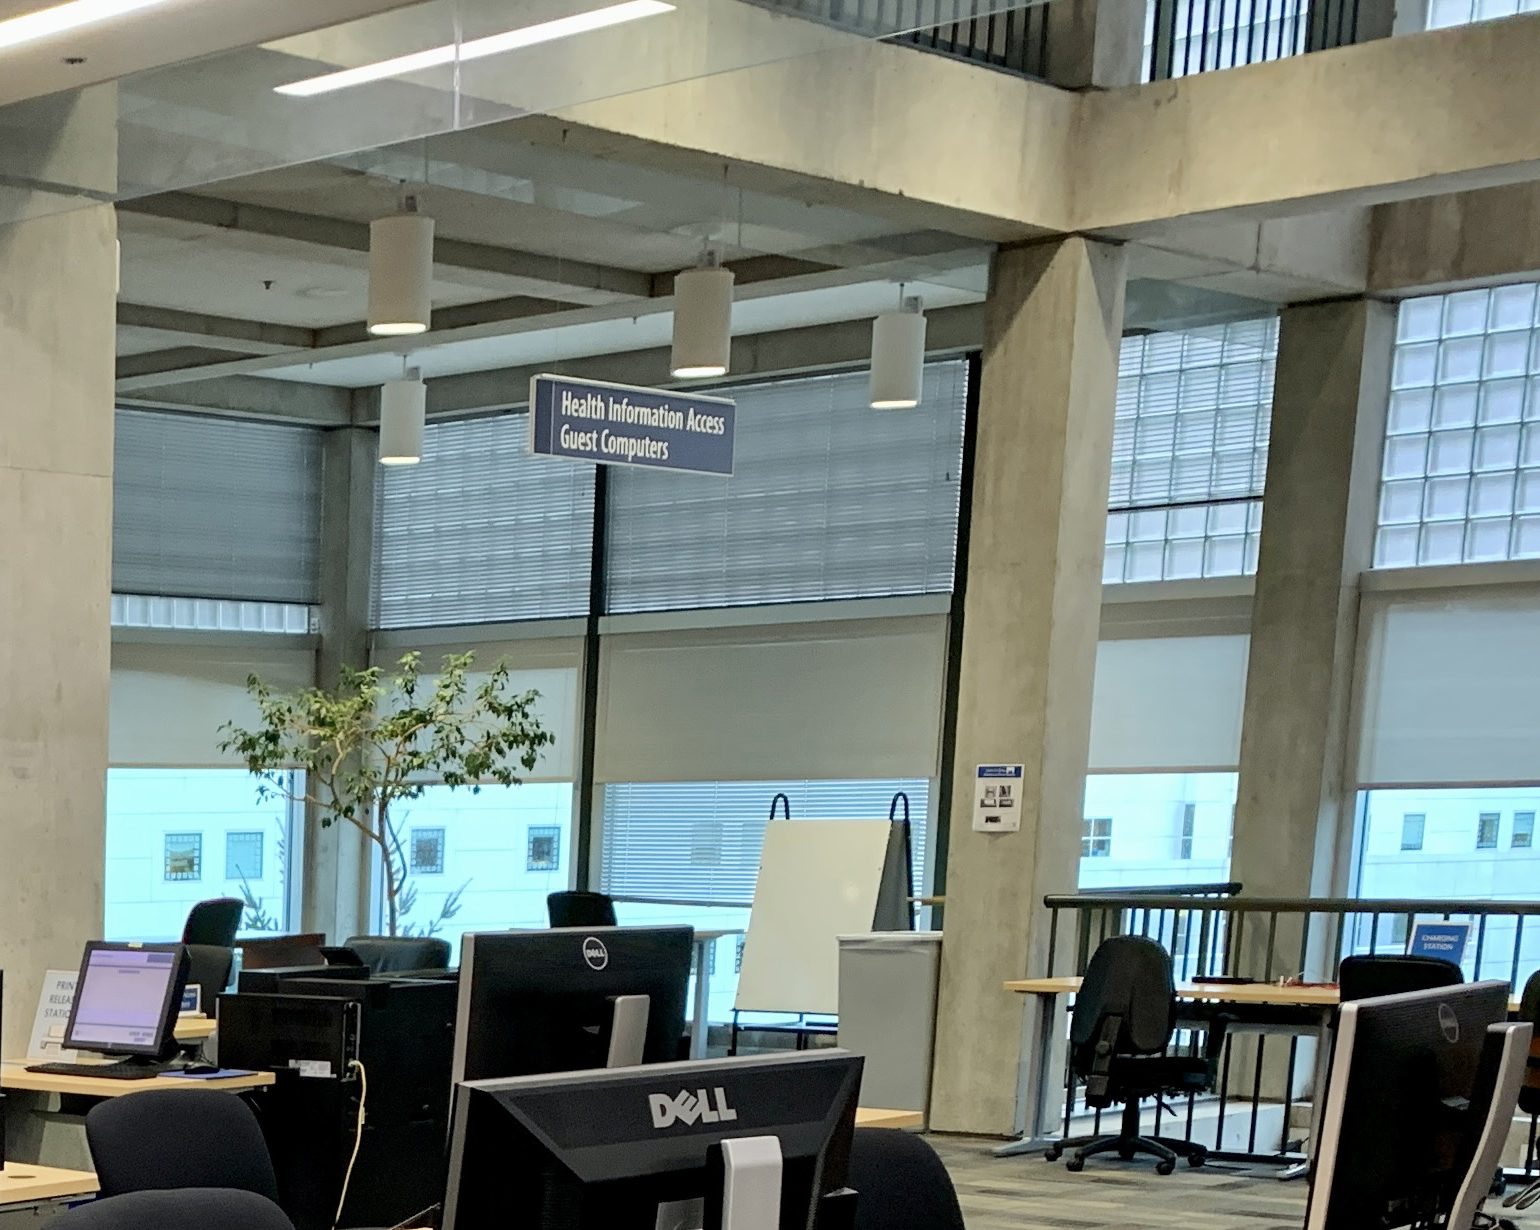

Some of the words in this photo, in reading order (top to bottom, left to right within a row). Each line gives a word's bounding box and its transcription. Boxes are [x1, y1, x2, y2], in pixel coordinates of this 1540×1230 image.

[561, 391, 604, 419] Health
[608, 397, 683, 430] Information
[686, 407, 725, 435] Access
[560, 424, 597, 452] Guest
[600, 428, 669, 462] Computers
[1422, 934, 1459, 943] CHARGING
[586, 947, 606, 958] DELL
[1423, 943, 1454, 951] STATION
[56, 980, 78, 991] PRIN
[648, 1087, 738, 1128] DELL
